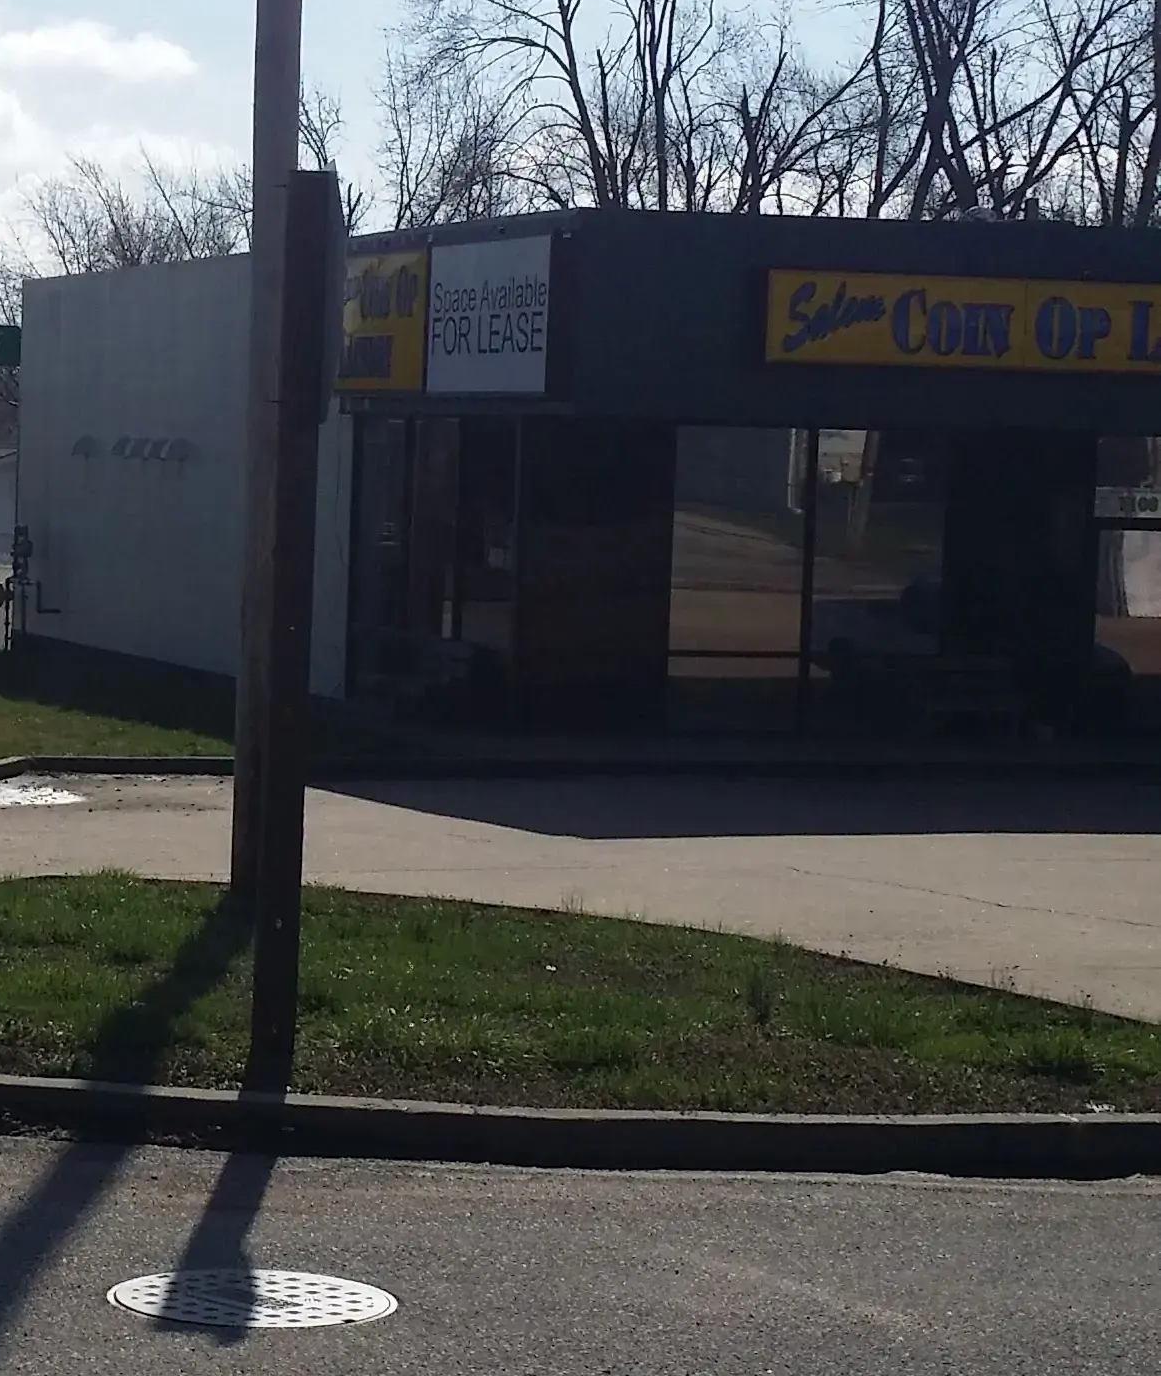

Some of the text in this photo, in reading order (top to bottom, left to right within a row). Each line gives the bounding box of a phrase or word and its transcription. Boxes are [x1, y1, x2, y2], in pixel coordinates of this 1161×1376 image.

[433, 274, 548, 314] Space Available
[431, 311, 545, 355] FOR LEASE
